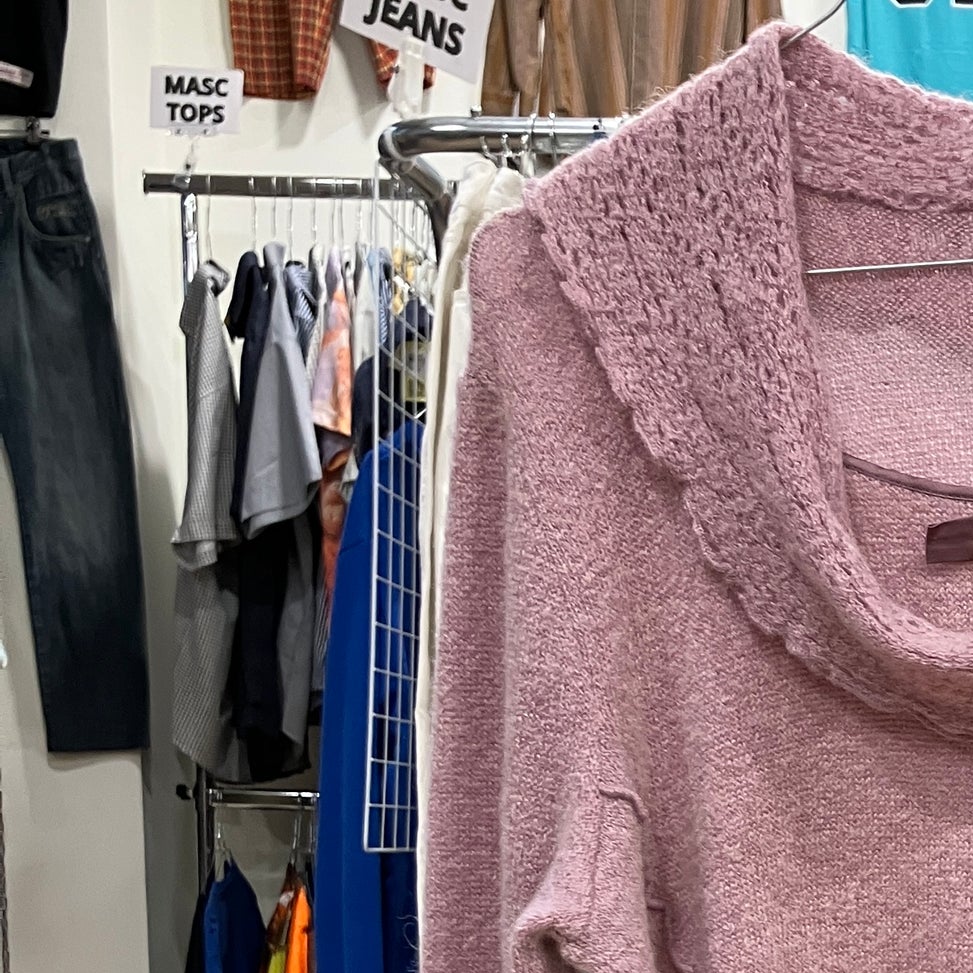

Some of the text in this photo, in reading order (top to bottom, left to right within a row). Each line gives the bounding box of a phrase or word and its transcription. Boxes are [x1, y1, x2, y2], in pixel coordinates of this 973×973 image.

[363, 0, 466, 56] JEANS
[165, 75, 229, 97] MASC
[166, 102, 225, 124] TOPS
